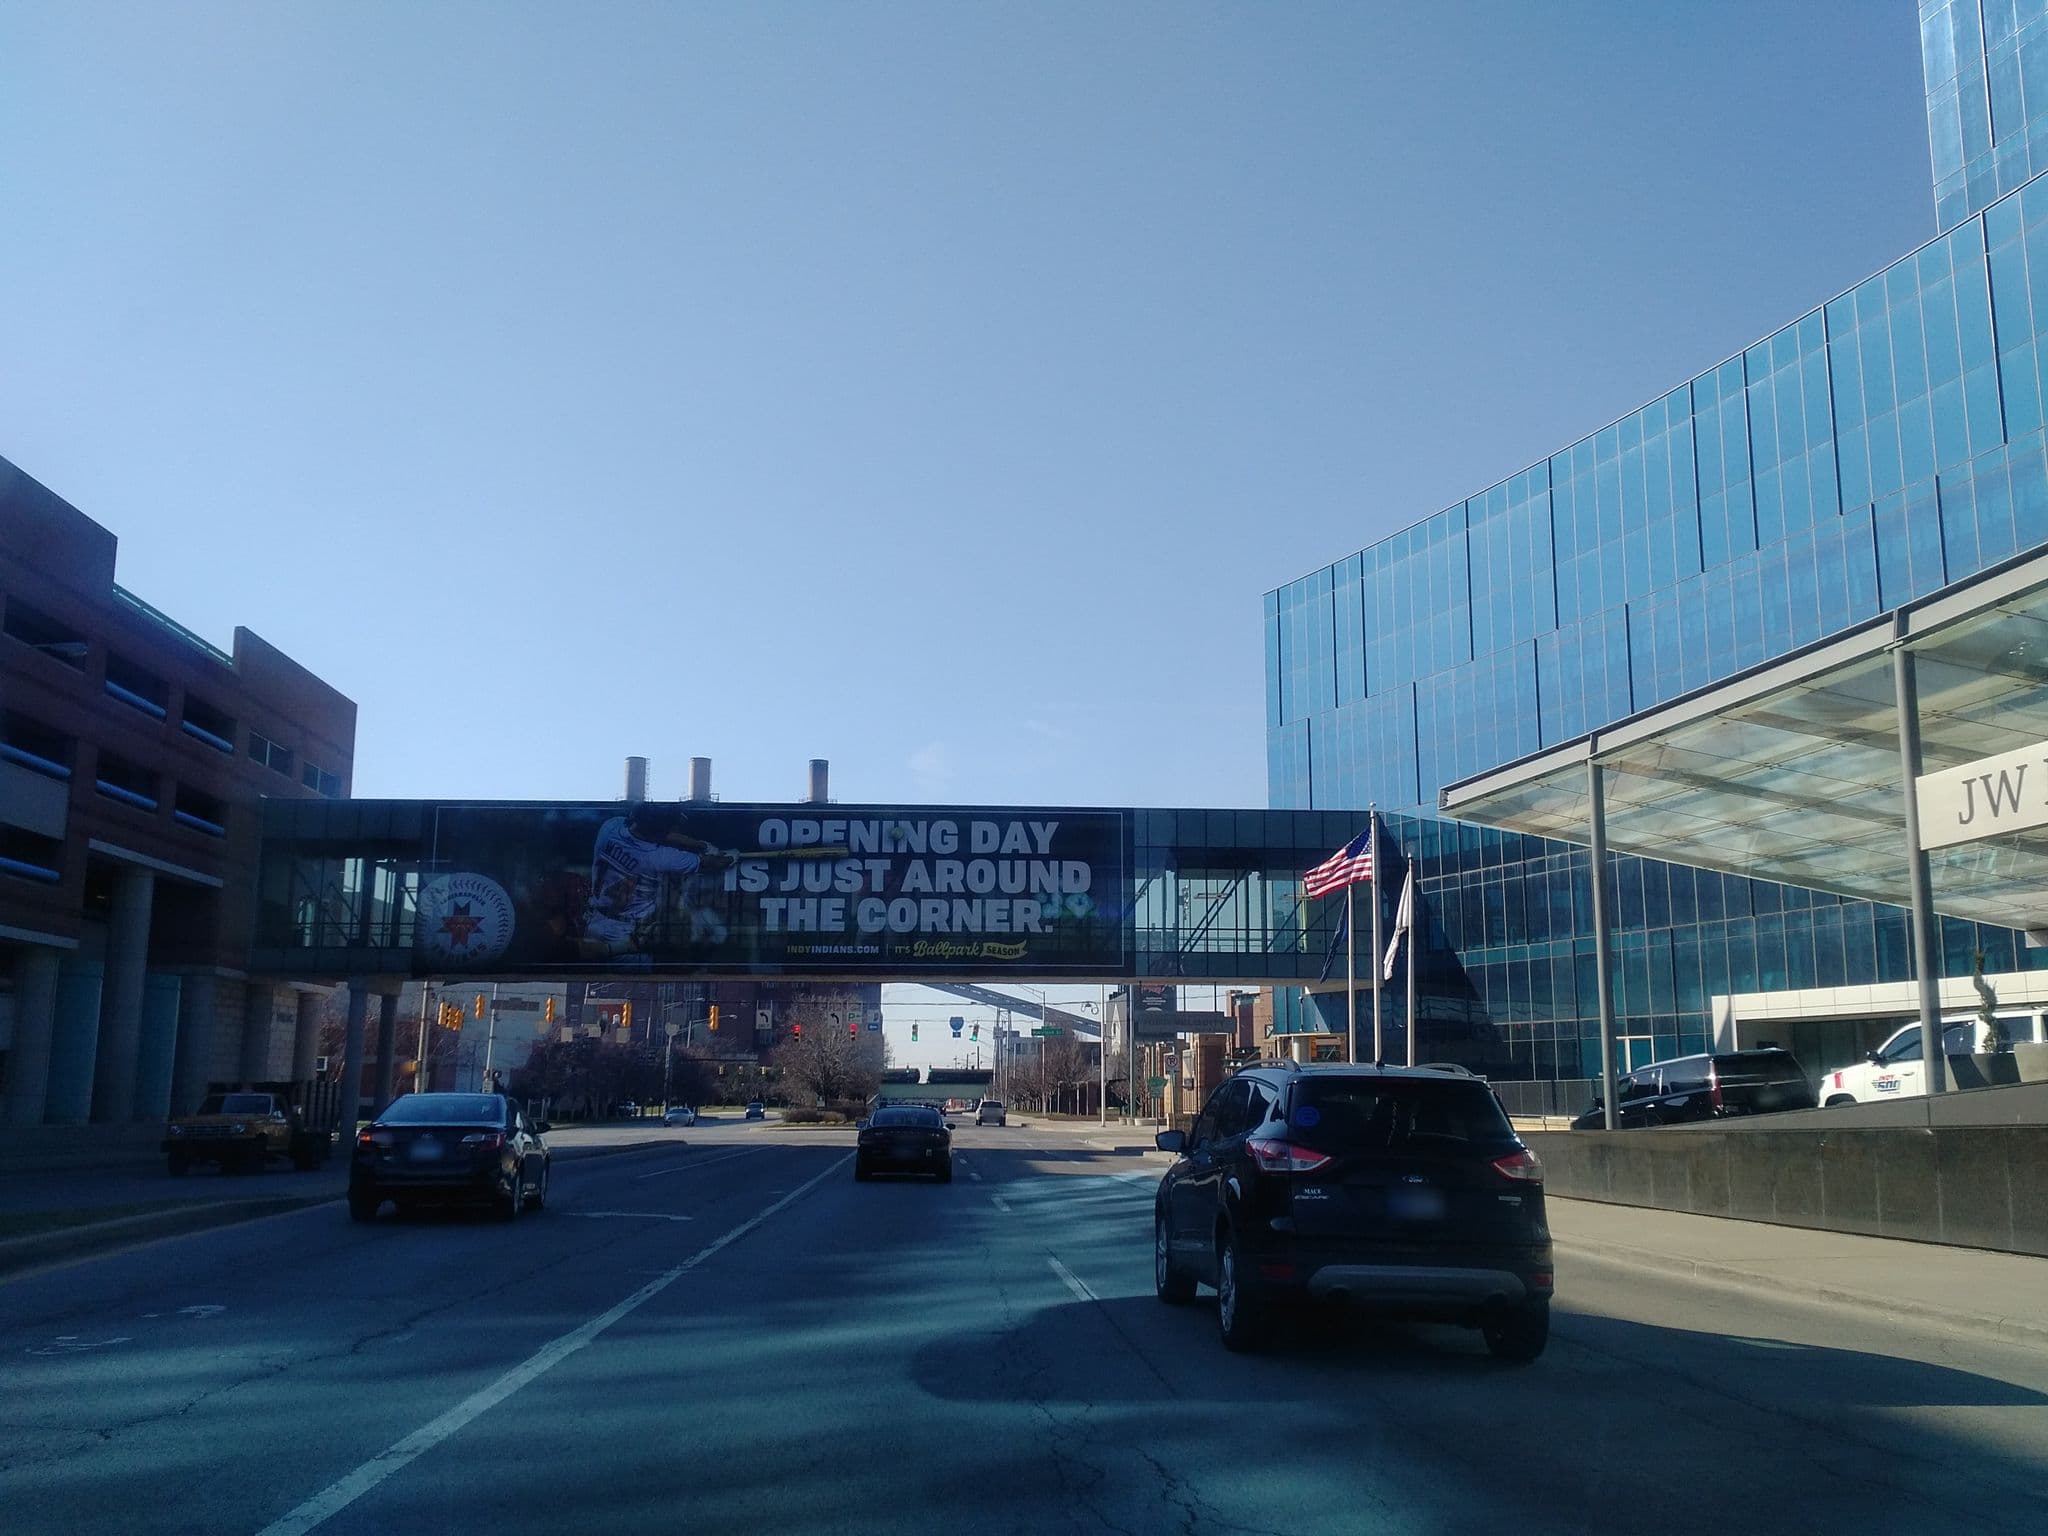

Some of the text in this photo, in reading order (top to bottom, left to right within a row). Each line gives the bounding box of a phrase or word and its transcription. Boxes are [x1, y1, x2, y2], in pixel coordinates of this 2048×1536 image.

[1958, 763, 2028, 825] JW
[758, 818, 1060, 854] OPENING DAY
[724, 858, 1091, 894] IS JUST AROUND
[759, 897, 1054, 933] THE CORNER.
[787, 945, 880, 954] INDYINDIANS.COM
[913, 940, 980, 959] Ballpark
[987, 944, 1020, 956] SEASON
